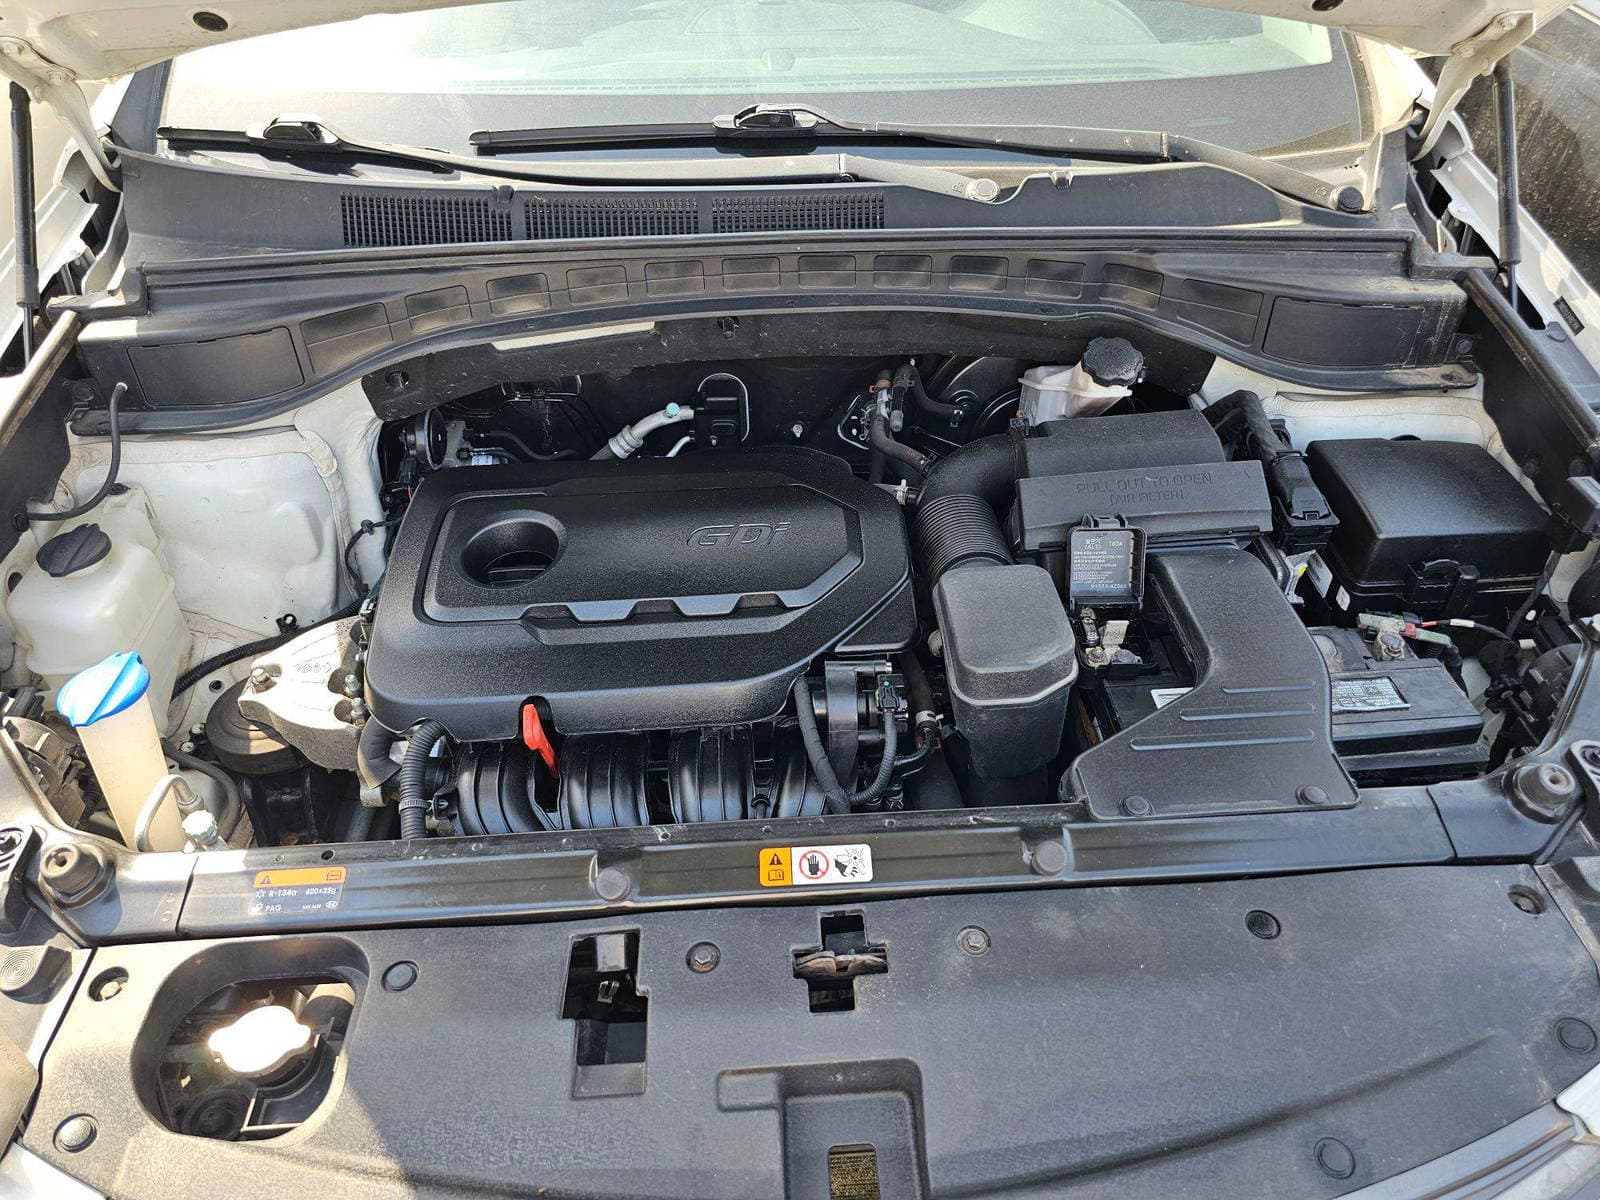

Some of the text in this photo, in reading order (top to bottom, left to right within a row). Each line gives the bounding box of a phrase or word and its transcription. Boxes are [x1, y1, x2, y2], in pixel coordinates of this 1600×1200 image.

[1076, 472, 1212, 494] PULL OUT TO OPEN
[268, 888, 297, 898] R-134a
[264, 904, 282, 912] PAG
